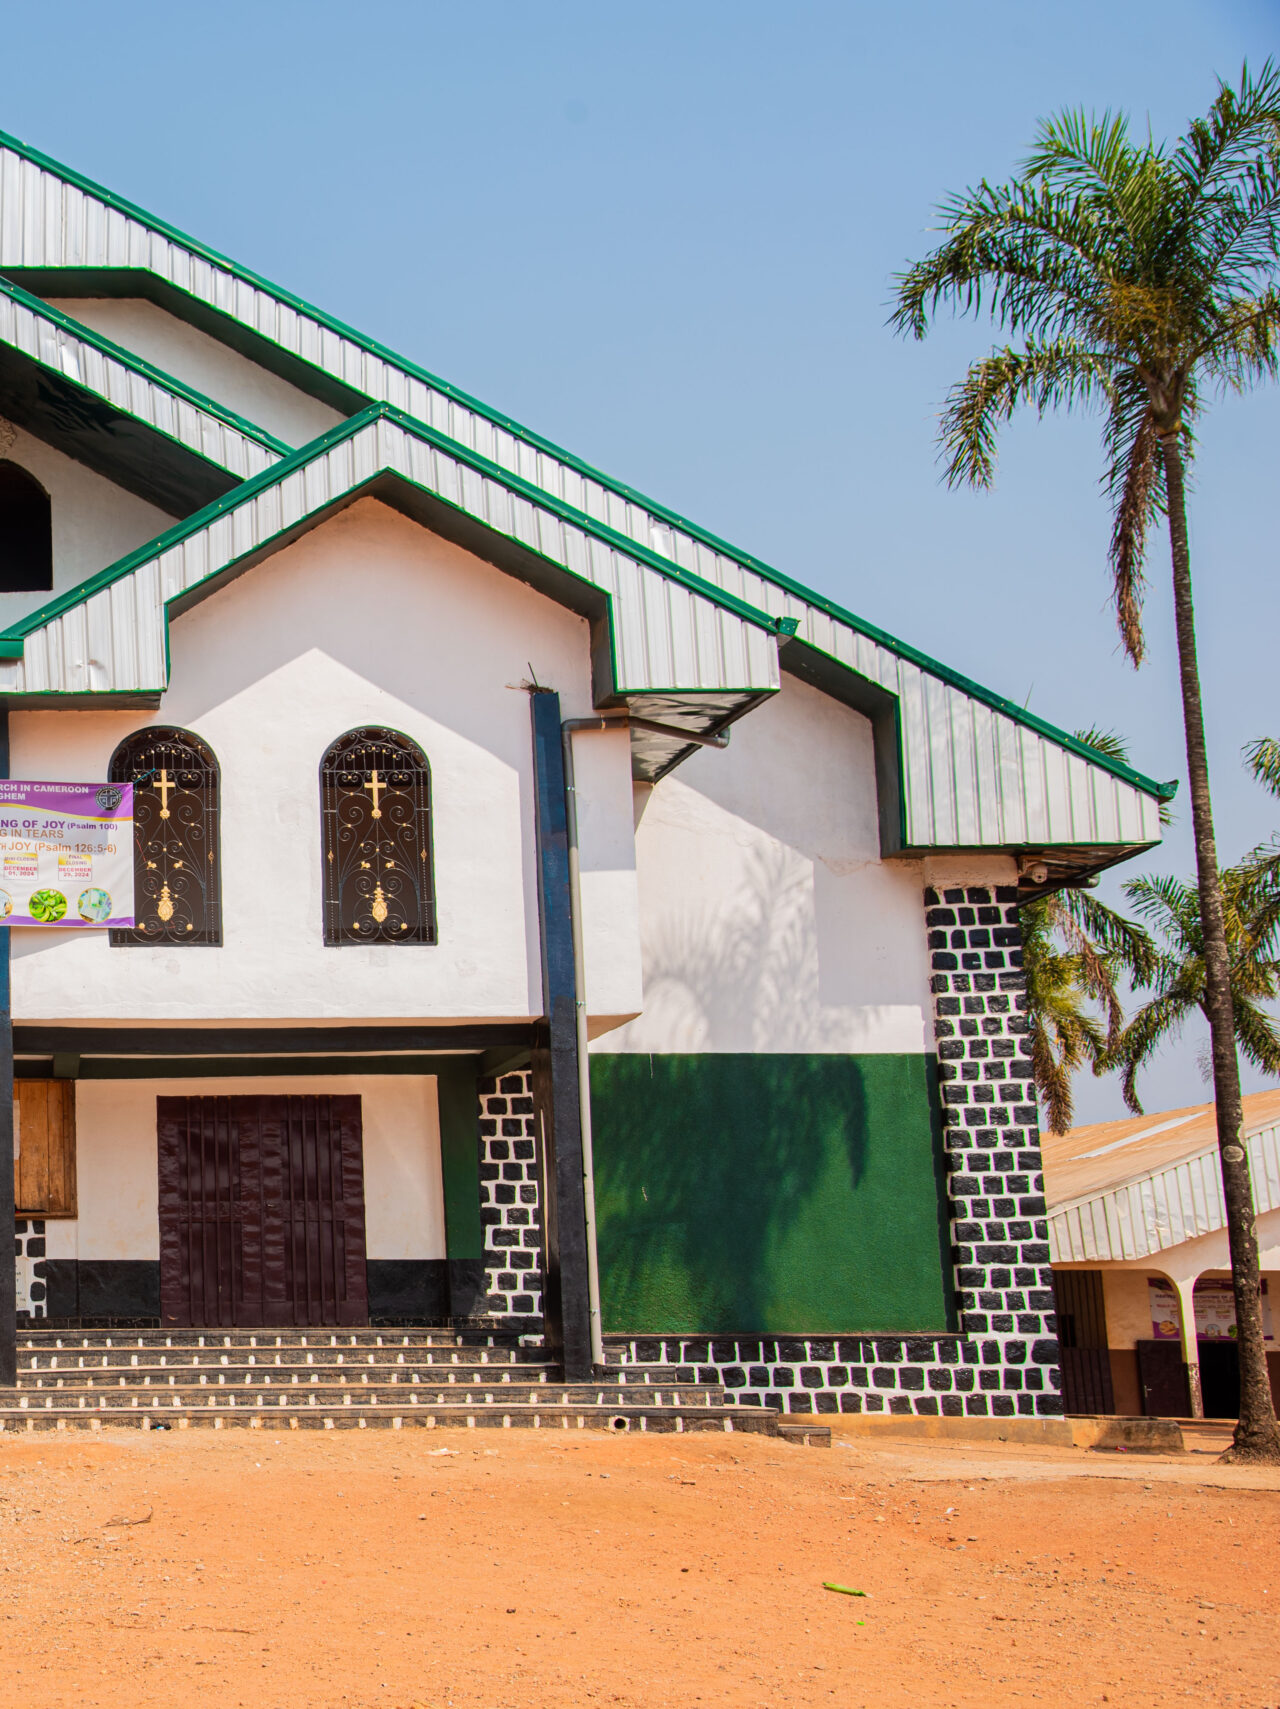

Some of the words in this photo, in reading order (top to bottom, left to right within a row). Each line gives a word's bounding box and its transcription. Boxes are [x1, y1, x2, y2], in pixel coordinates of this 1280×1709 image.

[20, 784, 30, 792] IN
[33, 784, 89, 794] CAMEROON
[22, 820, 38, 828] OF
[42, 820, 65, 829] JOY
[67, 822, 96, 831] (Psalm
[99, 822, 118, 831] 100)
[11, 829, 23, 838] IN
[26, 829, 64, 839] TEARS
[8, 841, 31, 851] JOY
[34, 842, 72, 854] (Psalm
[75, 843, 117, 854] 126:5-6)
